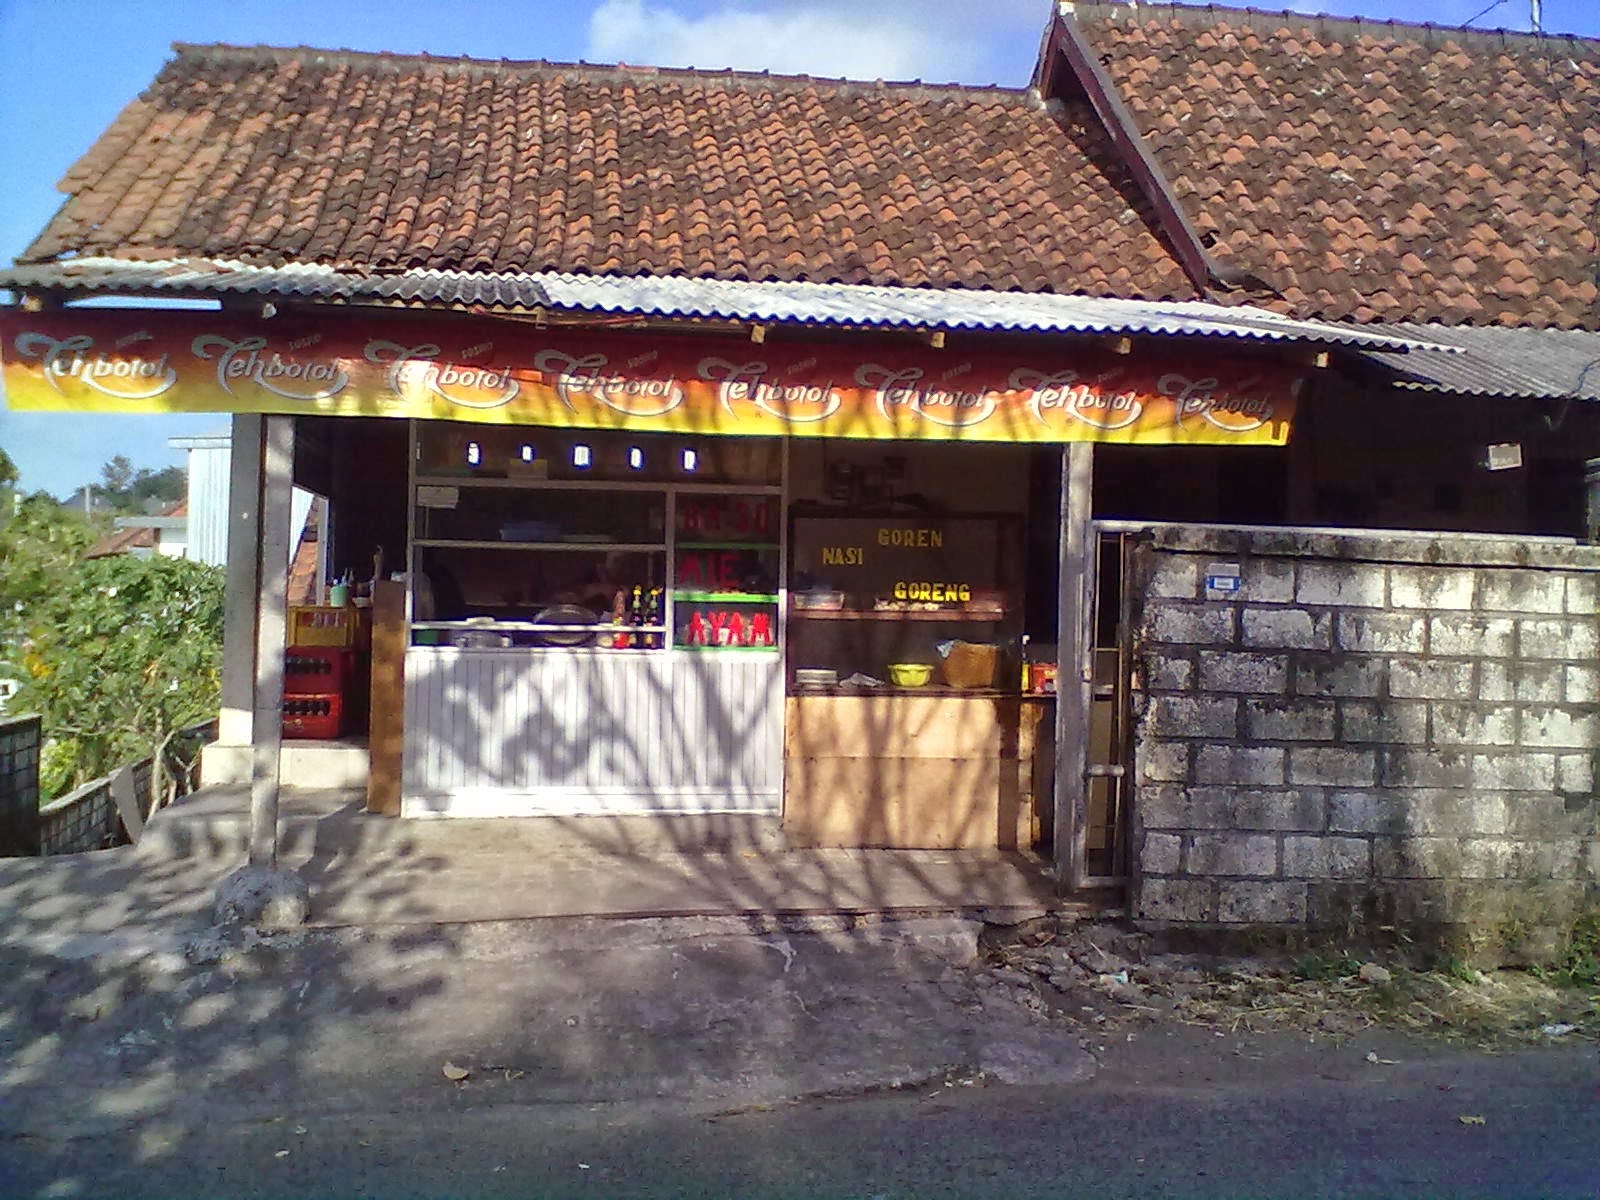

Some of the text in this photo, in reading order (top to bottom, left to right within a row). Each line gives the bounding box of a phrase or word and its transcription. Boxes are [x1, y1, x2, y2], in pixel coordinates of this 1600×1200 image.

[190, 332, 350, 401] Tehbotol
[876, 528, 944, 548] GOREN
[822, 547, 865, 566] NASI
[894, 580, 971, 602] GORENG
[687, 611, 773, 646] AYAM
